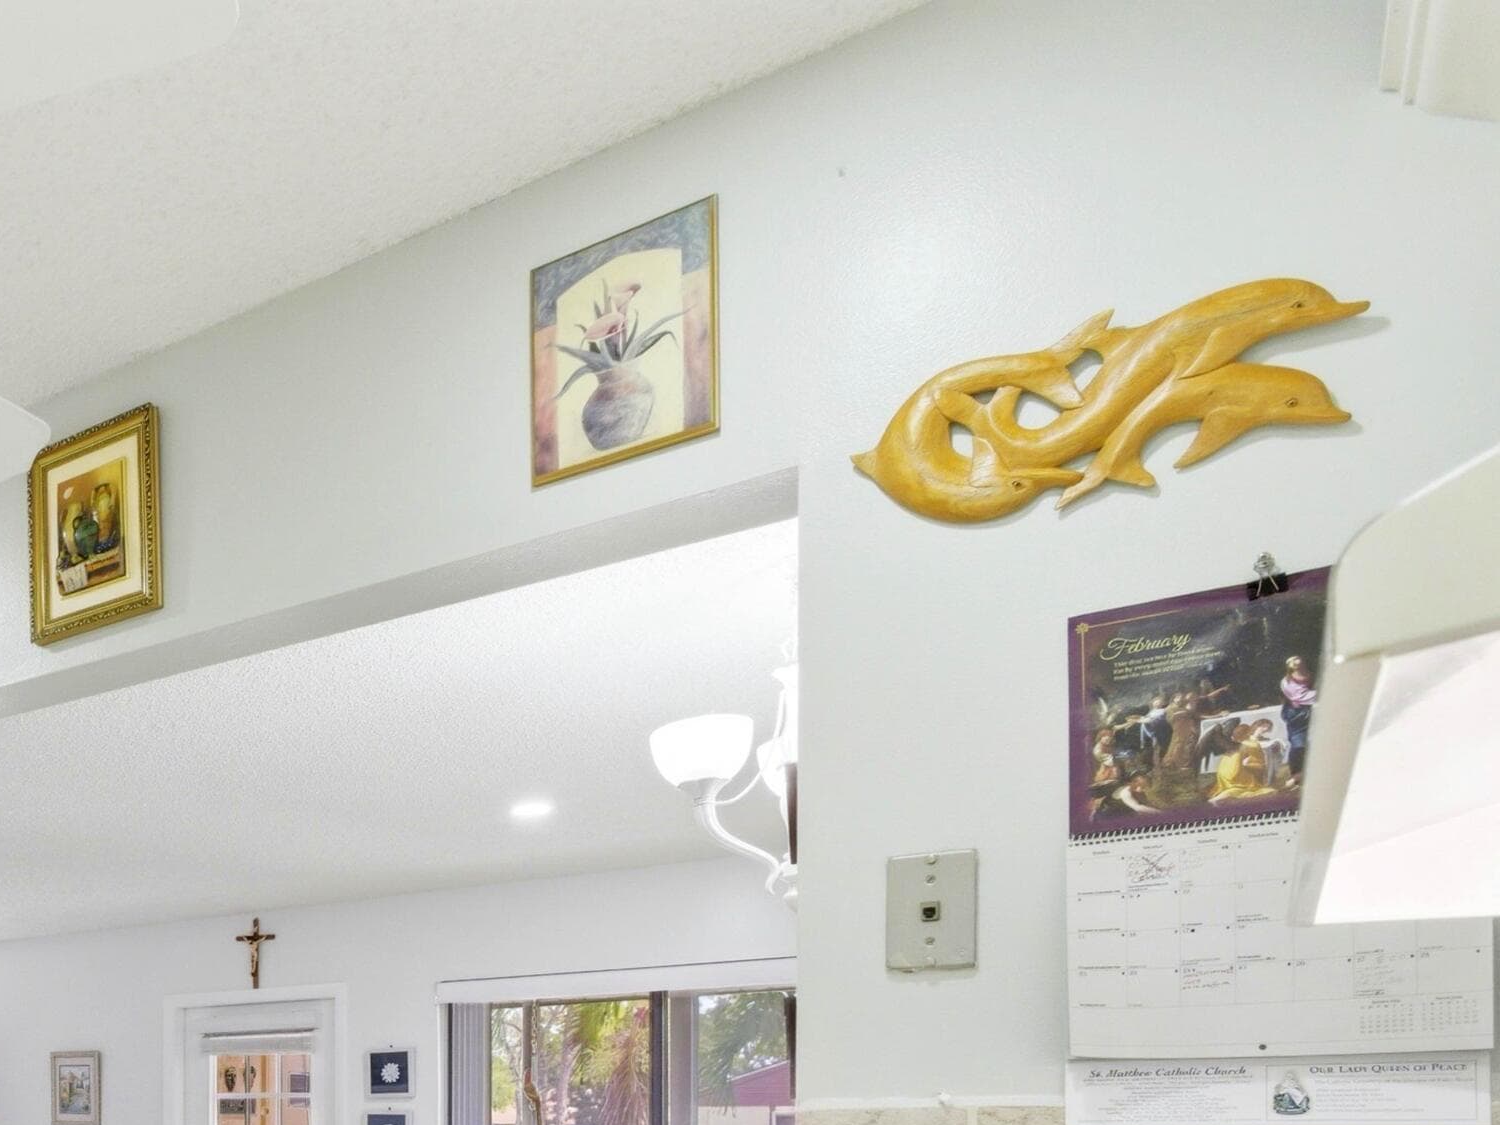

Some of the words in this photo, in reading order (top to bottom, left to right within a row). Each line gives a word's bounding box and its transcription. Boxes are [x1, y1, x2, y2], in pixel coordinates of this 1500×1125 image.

[1099, 633, 1191, 661] February
[1105, 1067, 1153, 1078] Matthew
[1155, 1066, 1202, 1077] Catholic
[1204, 1065, 1247, 1077] Church
